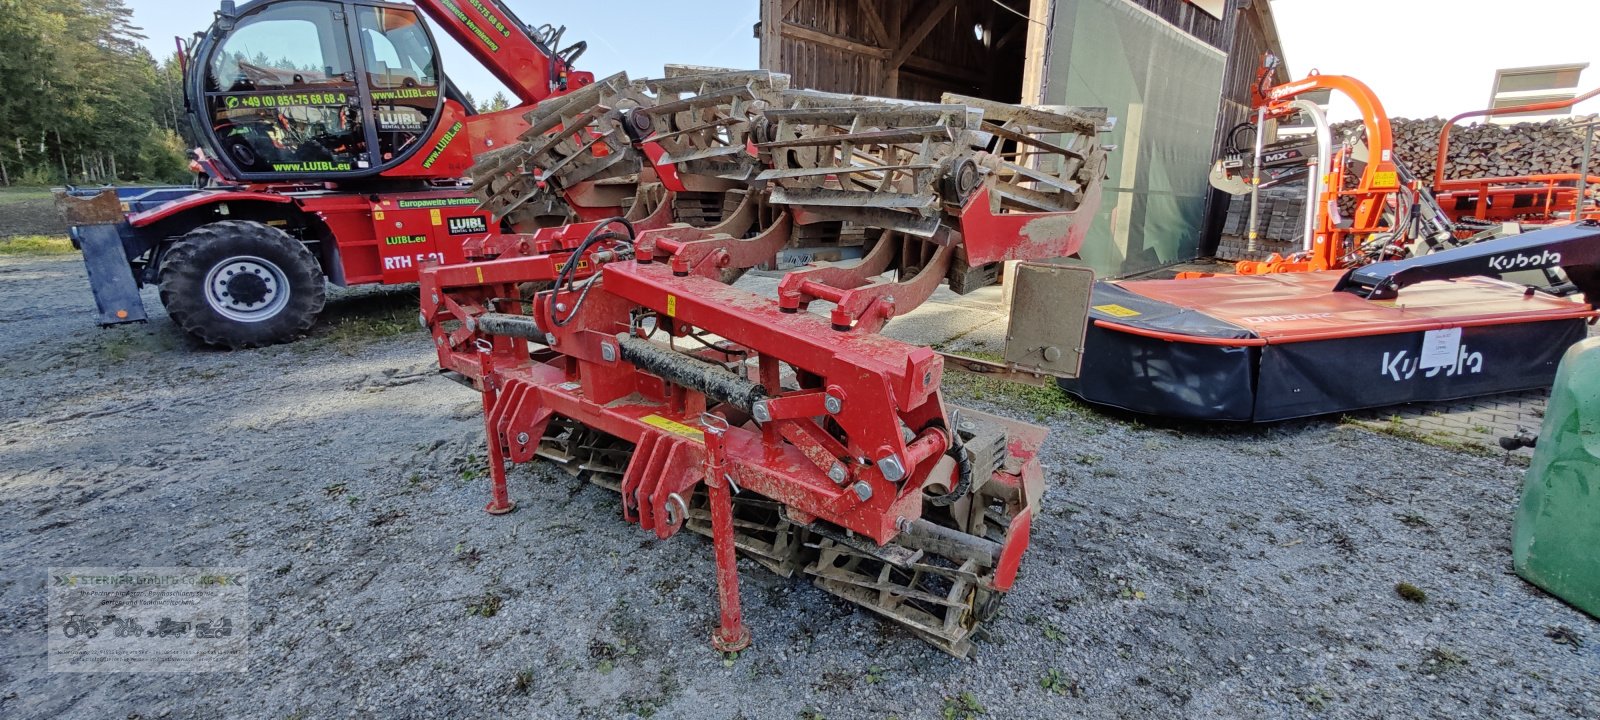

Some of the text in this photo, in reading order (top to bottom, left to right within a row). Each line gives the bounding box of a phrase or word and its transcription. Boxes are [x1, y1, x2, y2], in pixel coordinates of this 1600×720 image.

[466, 19, 499, 52] Vermietung
[242, 97, 260, 107] +49
[262, 95, 276, 107] (0)
[278, 94, 309, 106] 851-75
[310, 94, 322, 104] 68
[324, 93, 336, 104] 68
[371, 88, 438, 100] www.LUIBL.eu
[380, 113, 421, 125] LUIBL
[422, 121, 463, 170] www.LUIBL.eu
[272, 161, 351, 172] www.LUIBL.eu
[400, 197, 481, 208] Europaweite Vermietu
[449, 217, 485, 230] LUIBL
[386, 235, 426, 245] LUIBL.eu
[384, 255, 412, 270] RTH
[1489, 250, 1562, 270] Kubota
